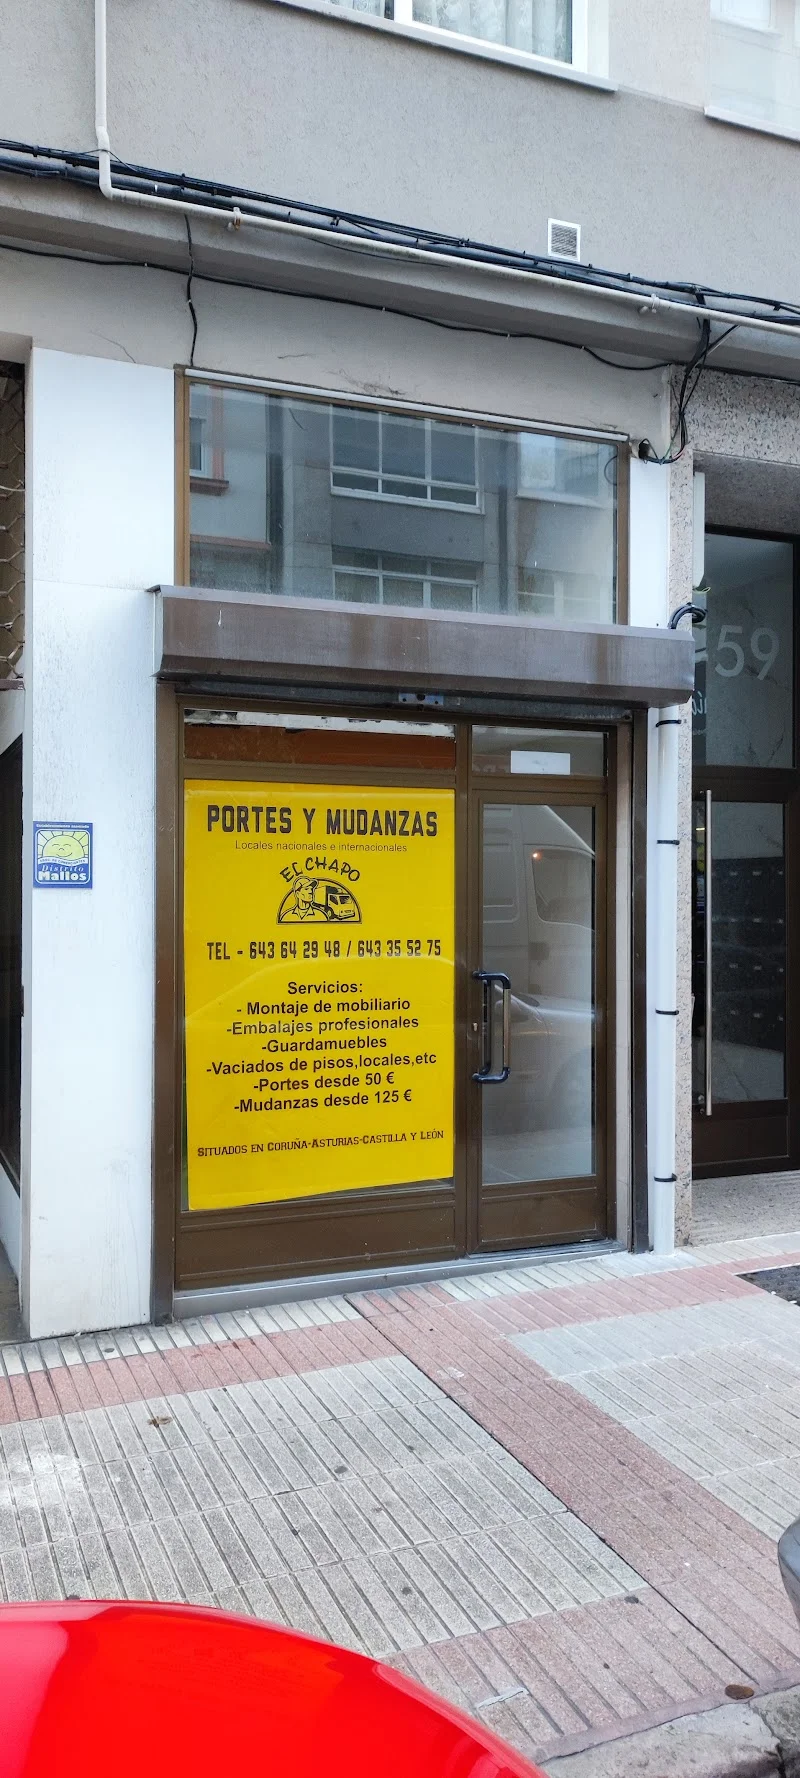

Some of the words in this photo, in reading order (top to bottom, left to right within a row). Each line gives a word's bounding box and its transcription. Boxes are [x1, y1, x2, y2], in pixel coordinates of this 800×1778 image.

[715, 625, 780, 680] 59
[208, 805, 291, 833] PORTES
[303, 808, 315, 834] Y
[327, 809, 437, 836] MUDANZAS
[236, 840, 273, 849] Locales
[277, 842, 327, 850] nacionales
[339, 843, 407, 851] internacionales
[38, 871, 87, 880] Mallos
[280, 862, 303, 883] EL
[304, 857, 360, 883] CHAPO
[207, 942, 230, 960] TEL
[250, 942, 274, 959] 643
[281, 941, 296, 958] 64
[303, 941, 318, 958] 29
[325, 941, 340, 957] 48
[358, 940, 381, 957] 643
[387, 940, 401, 957] 35
[407, 940, 421, 957] 52
[427, 940, 440, 956] 75
[288, 981, 362, 994] Servicios:
[248, 1001, 308, 1016] Montaje
[314, 1000, 331, 1012] de
[337, 998, 410, 1011] mobiliario
[319, 1016, 418, 1034] profesionales
[290, 1058, 307, 1070] de
[315, 1074, 359, 1088] desde
[366, 1073, 381, 1085] 50
[386, 1072, 394, 1084] €
[324, 1093, 368, 1106] desde
[375, 1090, 399, 1103] 125
[404, 1089, 411, 1101] €
